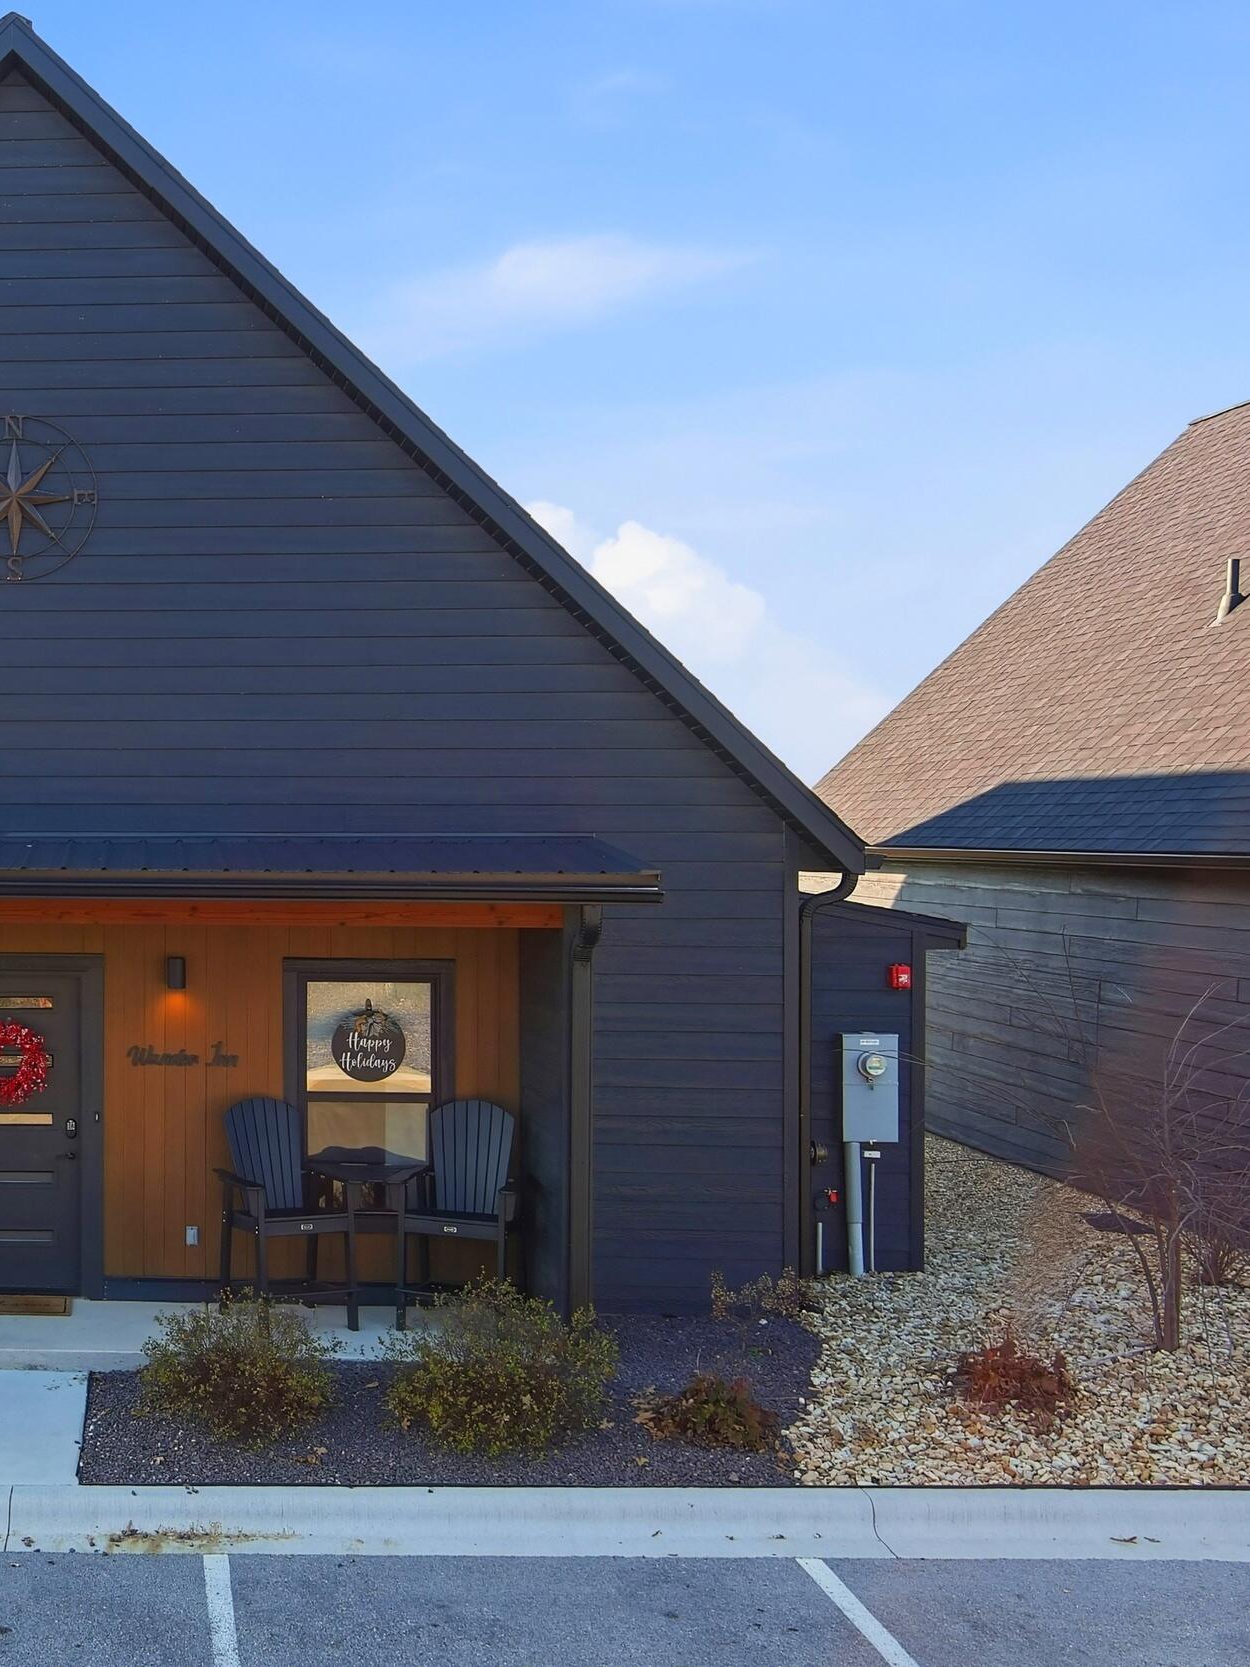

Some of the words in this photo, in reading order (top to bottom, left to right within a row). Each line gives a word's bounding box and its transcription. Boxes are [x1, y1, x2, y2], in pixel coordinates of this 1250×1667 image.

[4, 415, 23, 439] N
[73, 489, 97, 505] E
[6, 556, 23, 581] S
[346, 1031, 392, 1053] Happy
[340, 1052, 396, 1073] Holidays
